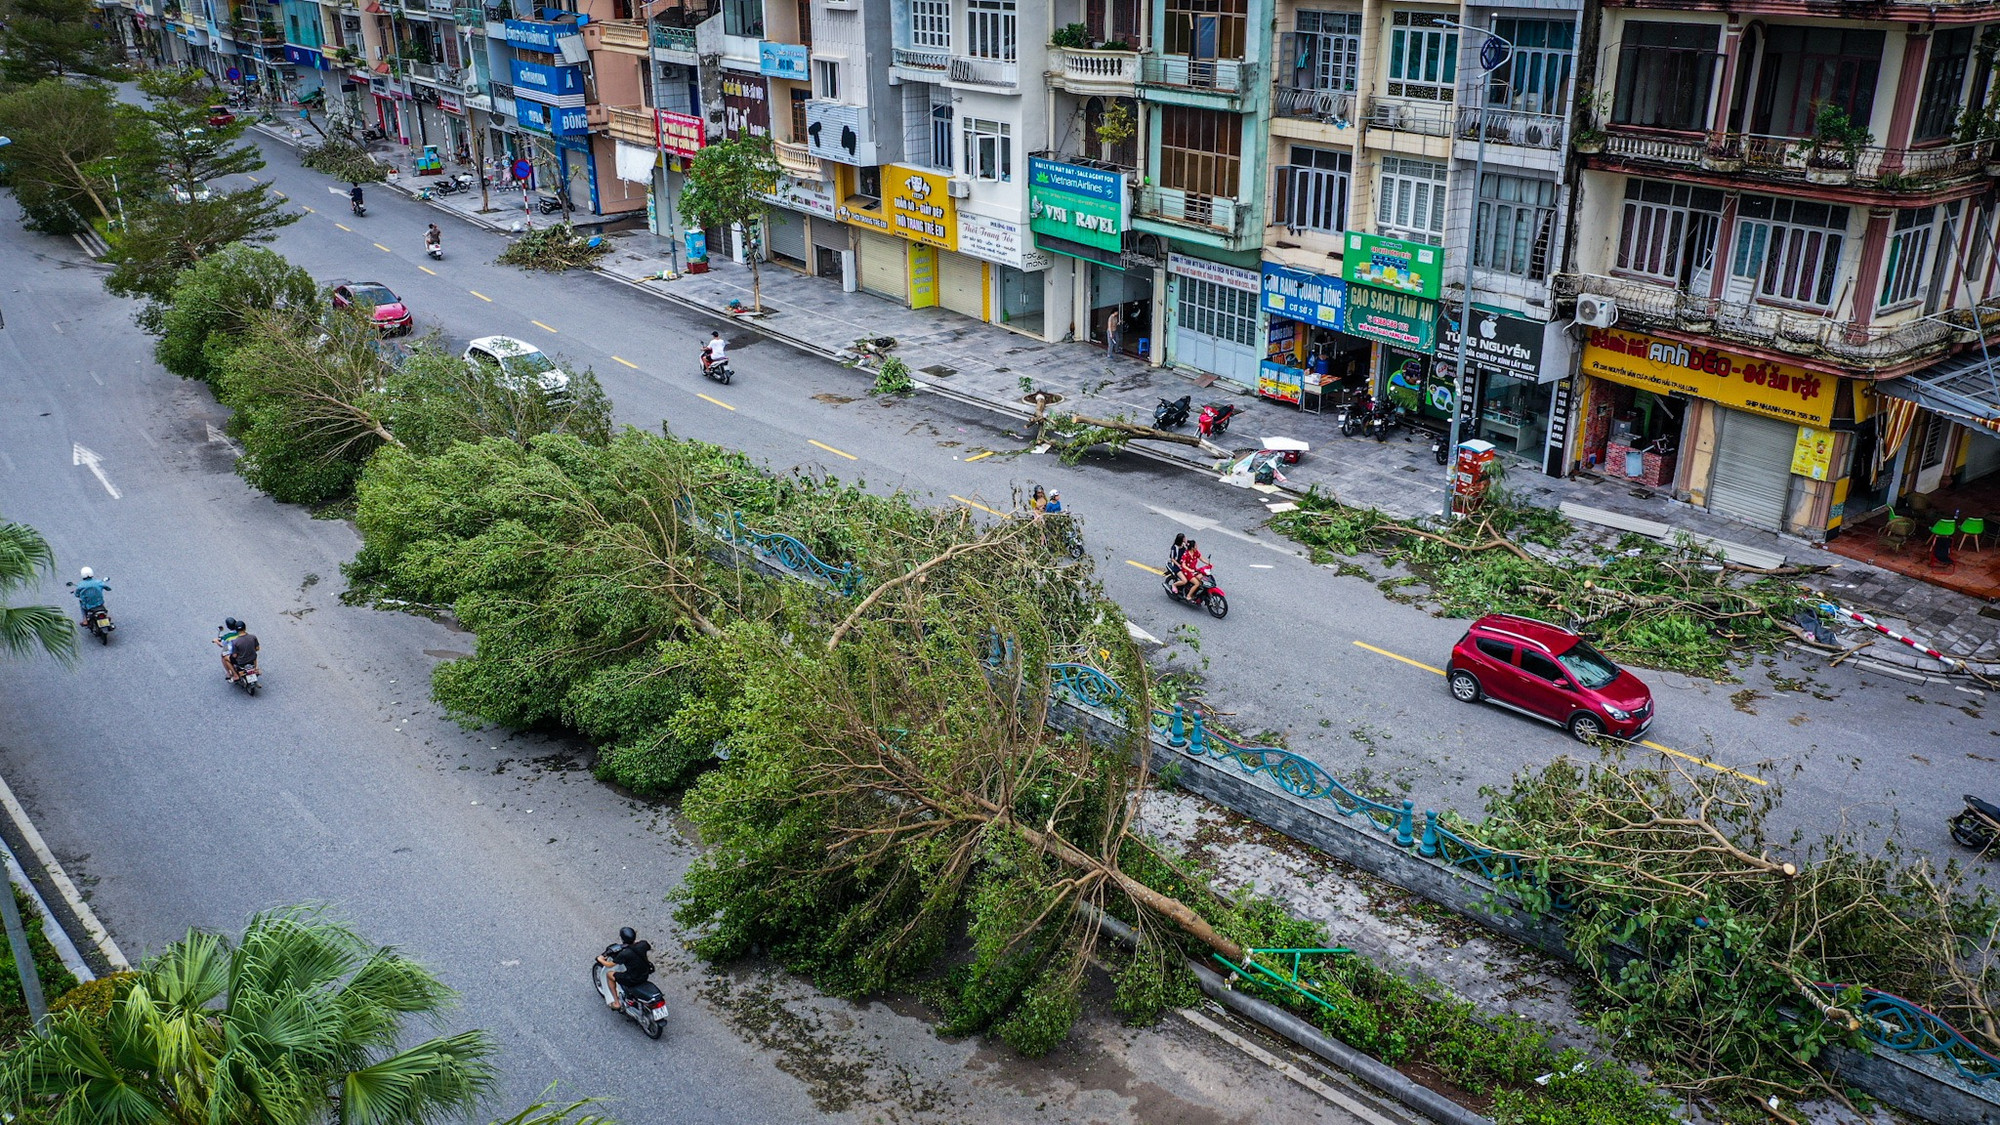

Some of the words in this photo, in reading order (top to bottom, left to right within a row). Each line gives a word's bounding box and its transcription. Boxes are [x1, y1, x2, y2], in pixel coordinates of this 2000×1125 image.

[1045, 205, 1067, 223] VNI
[907, 218, 924, 232] TRANG
[936, 226, 944, 237] EM
[979, 227, 1000, 241] Trang
[1280, 277, 1298, 298] RANG
[1308, 308, 1313, 316] 2
[1351, 287, 1368, 309] GẠO
[1370, 291, 1395, 313] SẠCH
[1398, 295, 1417, 318] TÂM
[1419, 302, 1433, 322] AN
[1480, 339, 1530, 360] NGUYỄN
[1490, 354, 1497, 362] ÉP
[1497, 356, 1510, 366] KÍNH
[1522, 363, 1535, 371] NGAY
[1746, 400, 1759, 408] SHIP
[1809, 414, 1820, 422] 300
